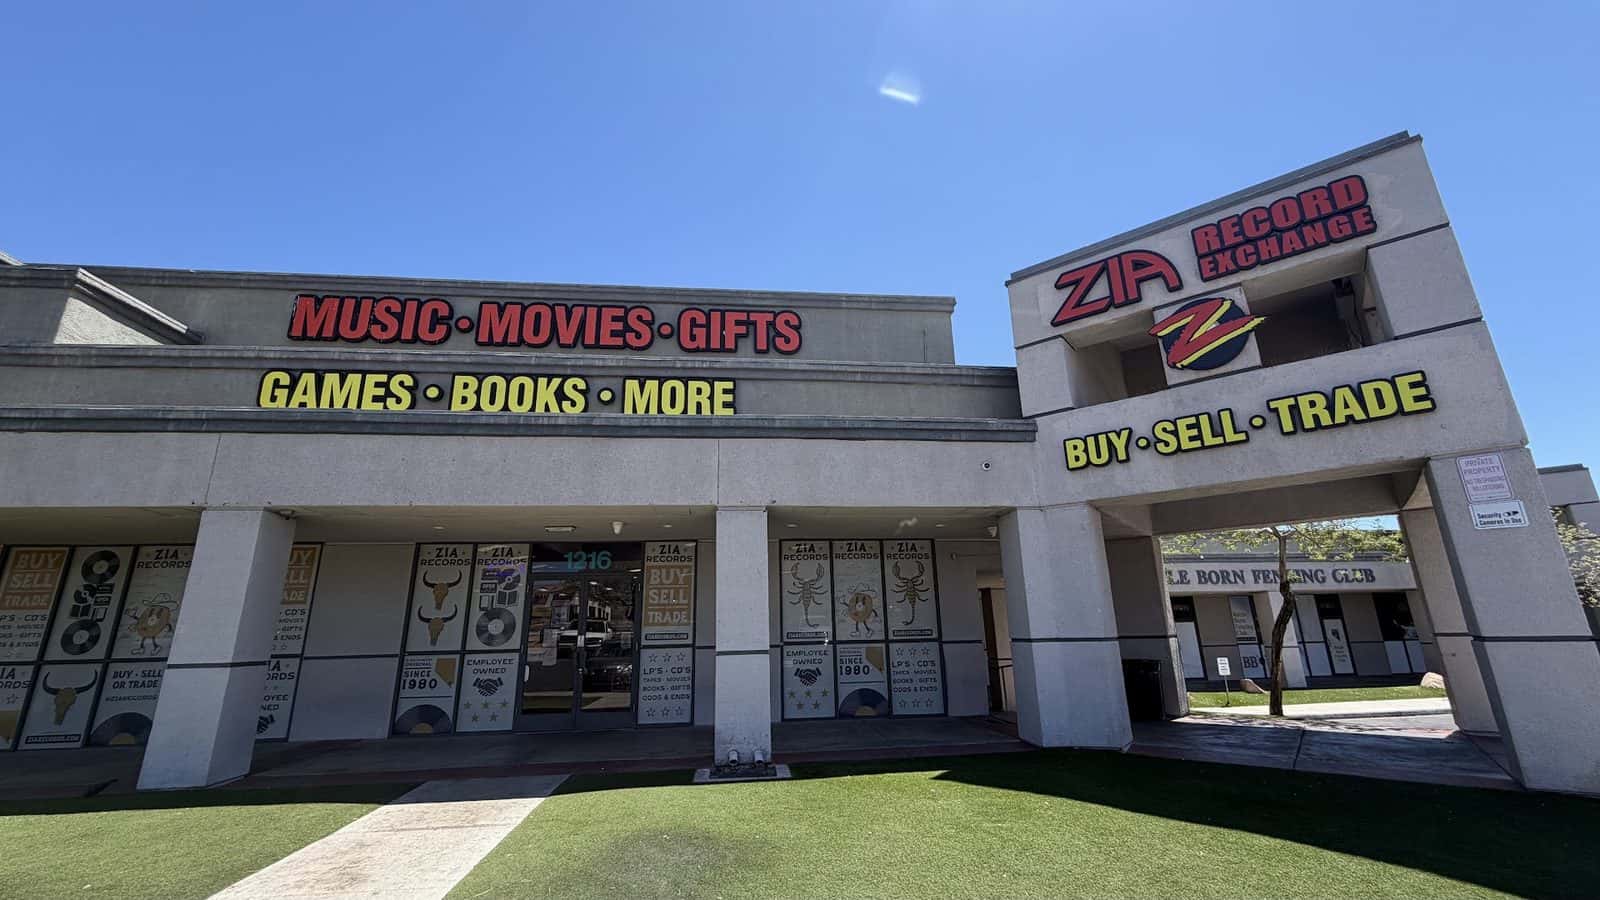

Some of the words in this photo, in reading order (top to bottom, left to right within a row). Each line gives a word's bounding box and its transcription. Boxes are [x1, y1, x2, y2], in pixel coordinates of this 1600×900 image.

[1192, 174, 1368, 256] RECORD
[1197, 205, 1377, 282] EXCHANGE
[1050, 249, 1183, 327] ZIA
[288, 294, 453, 344] MUSIC
[476, 302, 654, 351] MOVIES
[678, 308, 803, 354] GIFTS
[258, 369, 416, 411] GAMES
[449, 373, 590, 413] BOOKS
[622, 377, 736, 416] MORE
[1063, 427, 1132, 470] BUY
[1152, 408, 1249, 455] SELL
[1267, 370, 1436, 435] TRADE
[1477, 511, 1501, 520] Security
[492, 547, 513, 557] ZIA
[659, 544, 680, 554] ZIA
[794, 543, 816, 553] ZIA
[847, 542, 867, 552] ZIA
[897, 542, 917, 552] ZIA
[154, 549, 179, 561] ZIA
[435, 547, 458, 558] ZIA
[784, 553, 828, 561] RECORDS
[835, 552, 879, 560] RECORDS
[887, 552, 929, 560] RECORDS
[15, 551, 64, 569] BUY
[420, 558, 471, 566] RECORDS
[477, 558, 527, 566] RECORDS
[563, 550, 612, 570] 1216
[646, 555, 693, 563] RECORDS
[136, 560, 192, 569] RECORDS
[649, 568, 689, 585] BUY
[1196, 569, 1245, 585] BORN
[1331, 568, 1376, 584] CLUB
[8, 573, 54, 591] SELL
[4, 594, 50, 608] TRADE
[648, 589, 688, 604] SELL
[285, 608, 306, 616] CD'S
[647, 610, 688, 624] TRADE
[786, 649, 829, 657] EMPLOYEE
[466, 658, 514, 666] EMPLOYEE
[891, 660, 910, 668] LP'S
[112, 670, 133, 679] BUY
[141, 669, 163, 678] SELL
[403, 670, 431, 679] SINCE
[472, 667, 507, 675] OWNED
[642, 666, 664, 675] LP'S
[670, 665, 691, 674] CD'S
[839, 665, 870, 676] 1980
[112, 680, 126, 689] OR
[127, 679, 159, 689] TRADE
[402, 678, 438, 690] 1980
